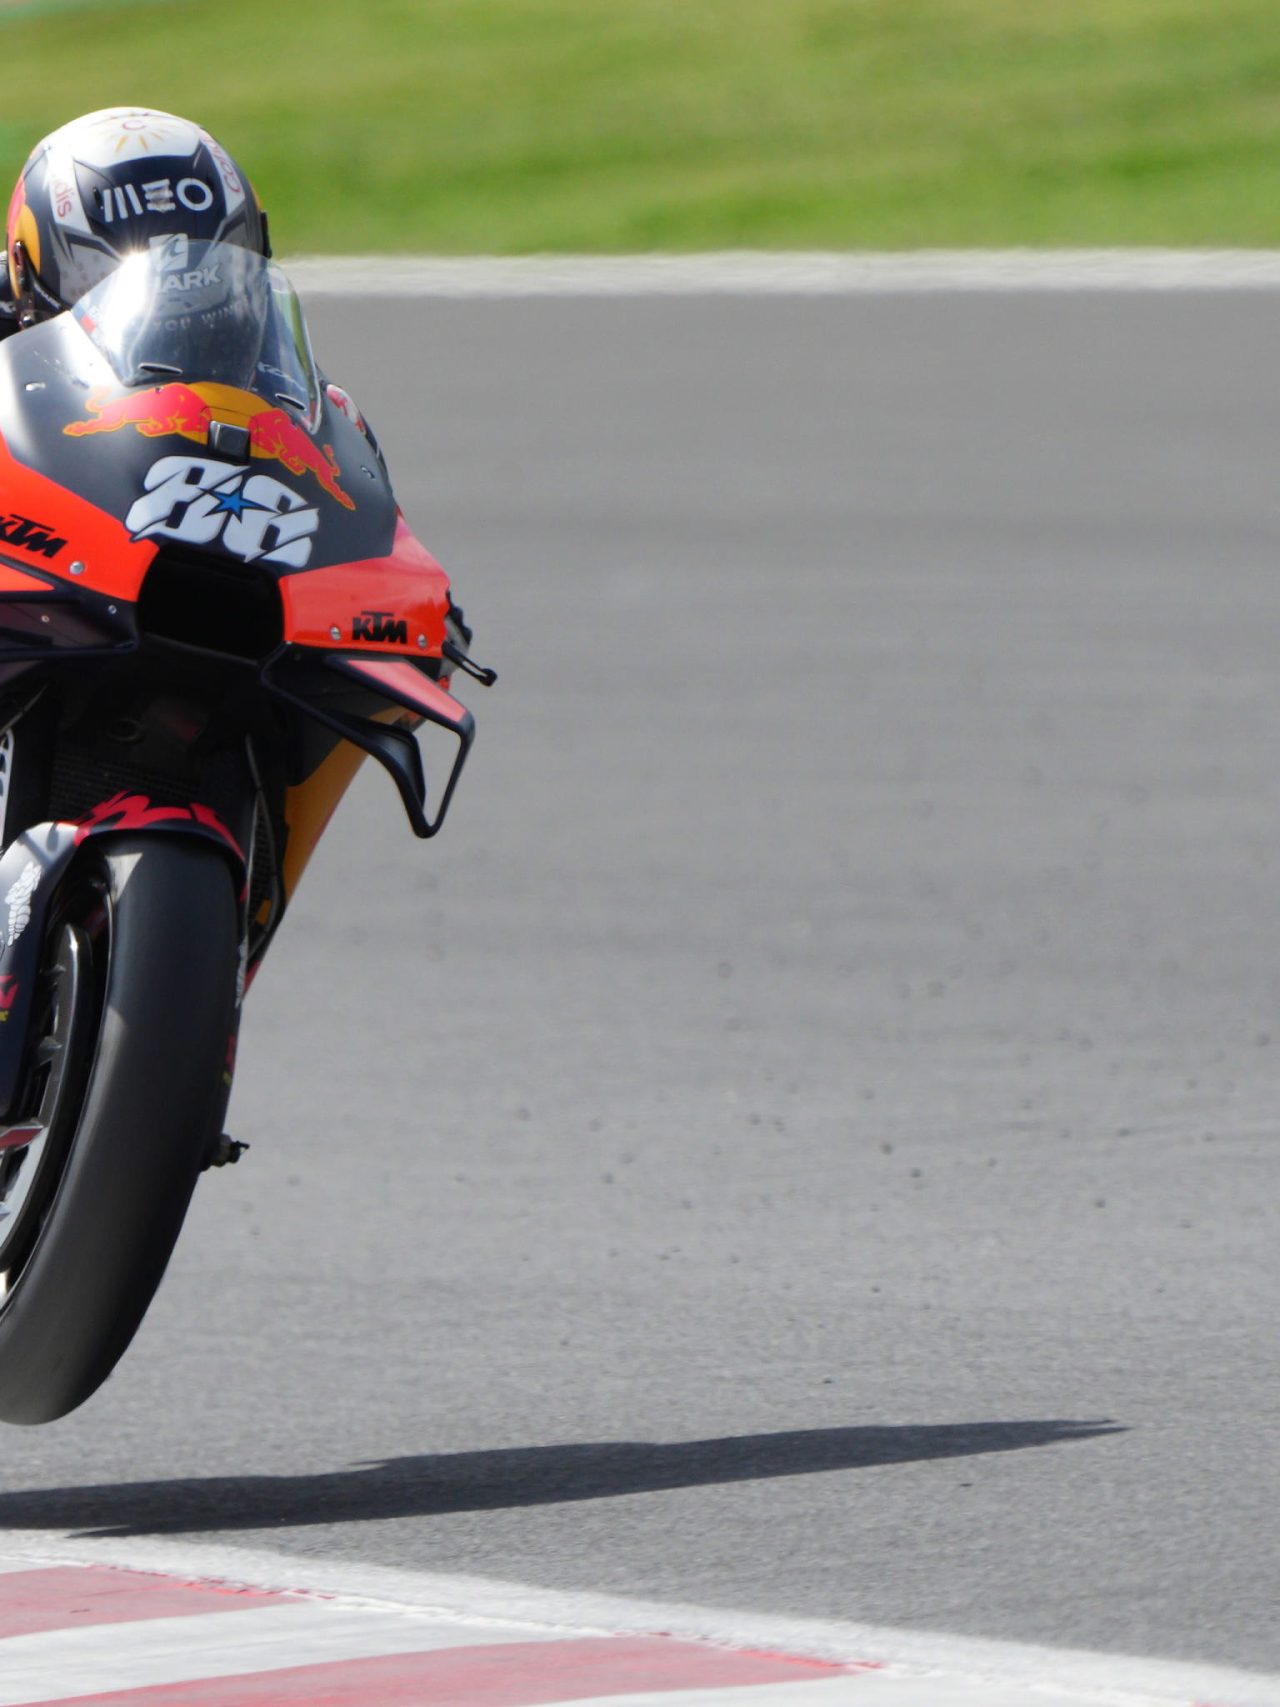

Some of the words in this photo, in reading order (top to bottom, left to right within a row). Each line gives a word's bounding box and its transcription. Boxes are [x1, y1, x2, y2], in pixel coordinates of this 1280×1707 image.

[103, 178, 214, 222] MEO
[158, 264, 222, 294] ARK
[124, 455, 319, 567] 88
[352, 610, 407, 645] KTM
